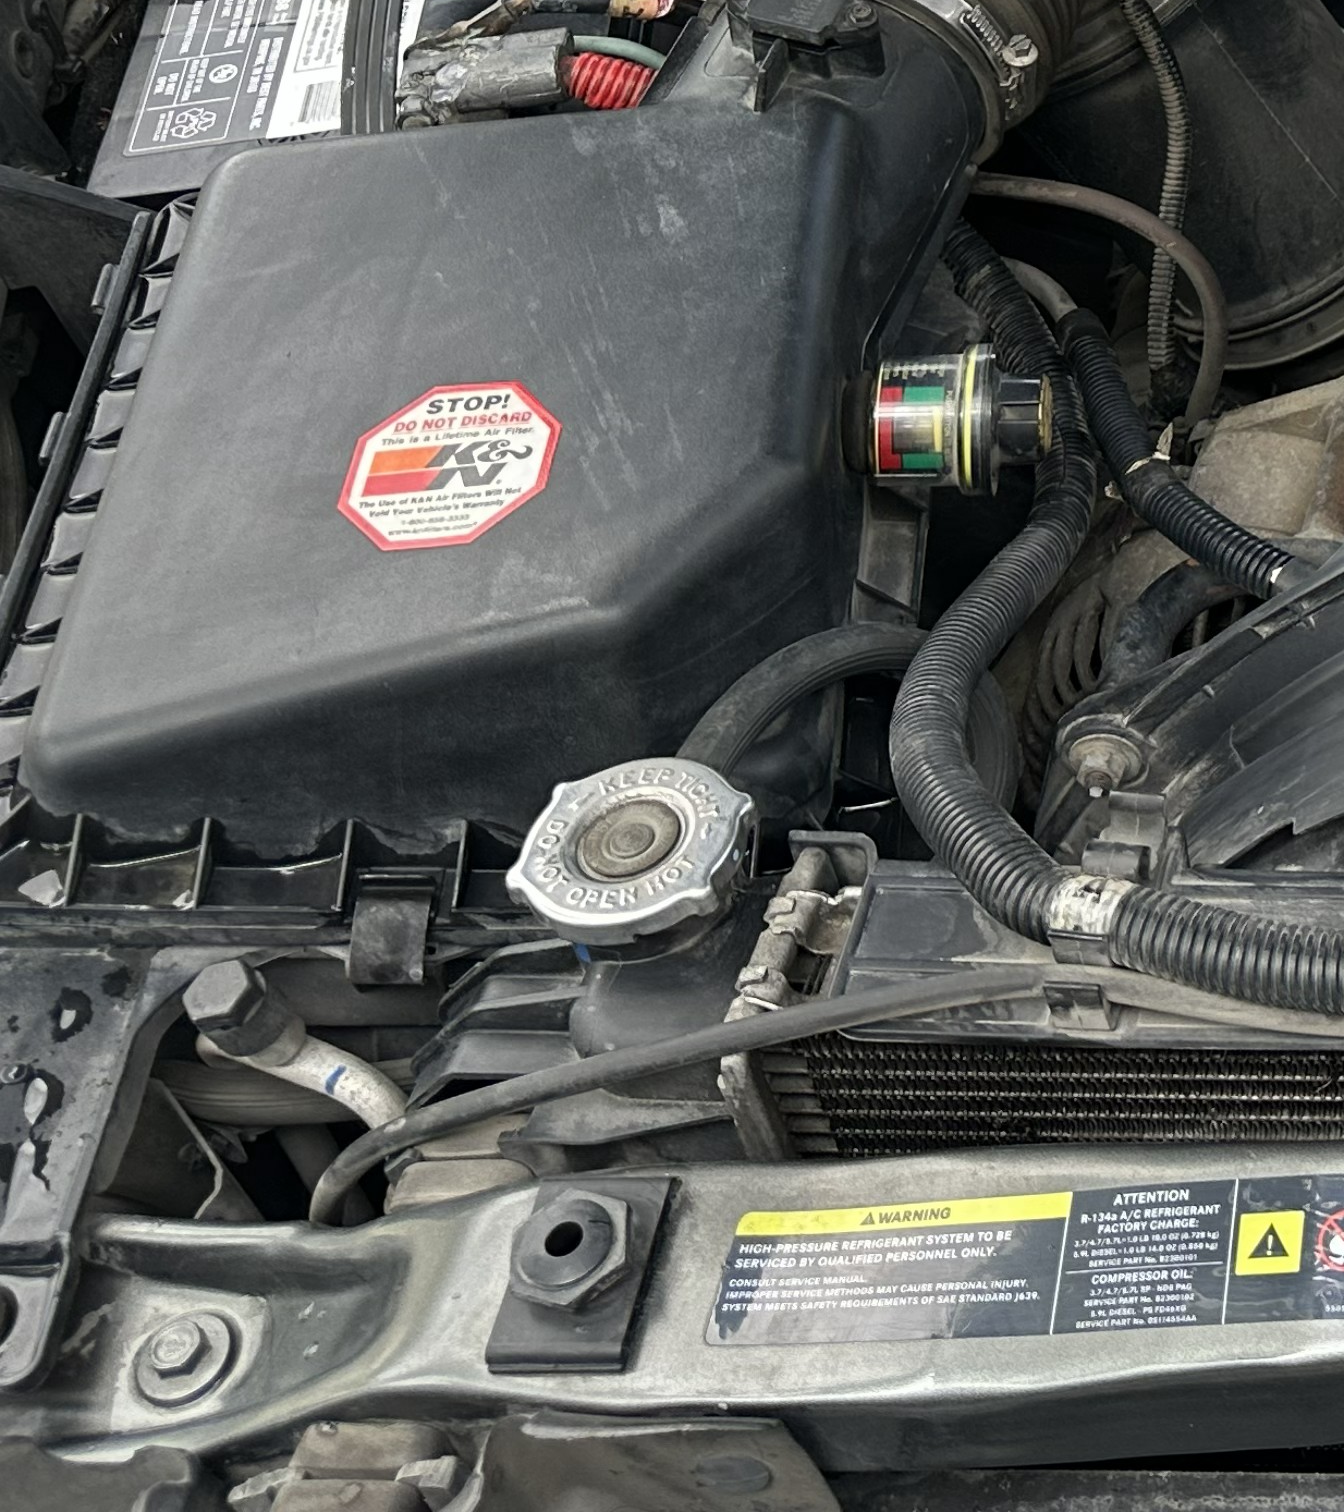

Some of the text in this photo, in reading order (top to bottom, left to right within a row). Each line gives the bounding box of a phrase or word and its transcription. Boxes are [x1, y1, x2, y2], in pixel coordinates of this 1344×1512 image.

[426, 394, 511, 415] STOP!
[394, 411, 532, 433] DO NOT DISCARD
[381, 438, 404, 446] This
[435, 430, 480, 440] Lifetime
[484, 428, 500, 436] Air
[378, 499, 396, 507] Use
[411, 496, 434, 504] K&N
[452, 491, 482, 500] Filters
[485, 488, 502, 496] Will
[369, 498, 505, 518] Void Your Vehicle's Warranty
[598, 768, 721, 819] KEEP TIGHT
[537, 819, 568, 850] DO
[565, 886, 638, 909] OPEN
[645, 854, 696, 896] HOT
[1113, 1189, 1190, 1206] ATTENTION
[878, 1207, 951, 1224] WARNING
[1080, 1204, 1221, 1224] R-134a A/C REFRIGERANT
[1097, 1218, 1200, 1234] FACTORY CHARGE:
[738, 1230, 1012, 1254] HIGH-PRESSURE REFRIGERANT SYSTEM TO BE
[734, 1246, 998, 1270] SERVICED BY QUALIFIED PERSONNEL ONLY.
[1088, 1258, 1122, 1268] SERVICE
[1123, 1256, 1143, 1266] PART
[728, 1275, 868, 1288] CONSULT SERVICE MANUAL.
[1090, 1268, 1194, 1285] COMPRESSOR OIL:
[726, 1278, 1028, 1300] IMPROPER SERVICE METHODS MAY CAUSE PERSONAL INJURY.
[722, 1302, 762, 1312] SYSTEM
[764, 1302, 798, 1311] MEETS
[800, 1300, 838, 1310] SAFETY
[840, 1296, 918, 1308] REQUIREMENTS
[921, 1295, 934, 1304] OF
[937, 1294, 956, 1304] SAE
[958, 1292, 1012, 1303] STANDARD
[1084, 1298, 1116, 1308] SERVICE
[1118, 1297, 1138, 1306] PART
[1108, 1308, 1137, 1316] DIESEL
[1076, 1320, 1109, 1329] SERVICE
[1110, 1318, 1130, 1327] PART
